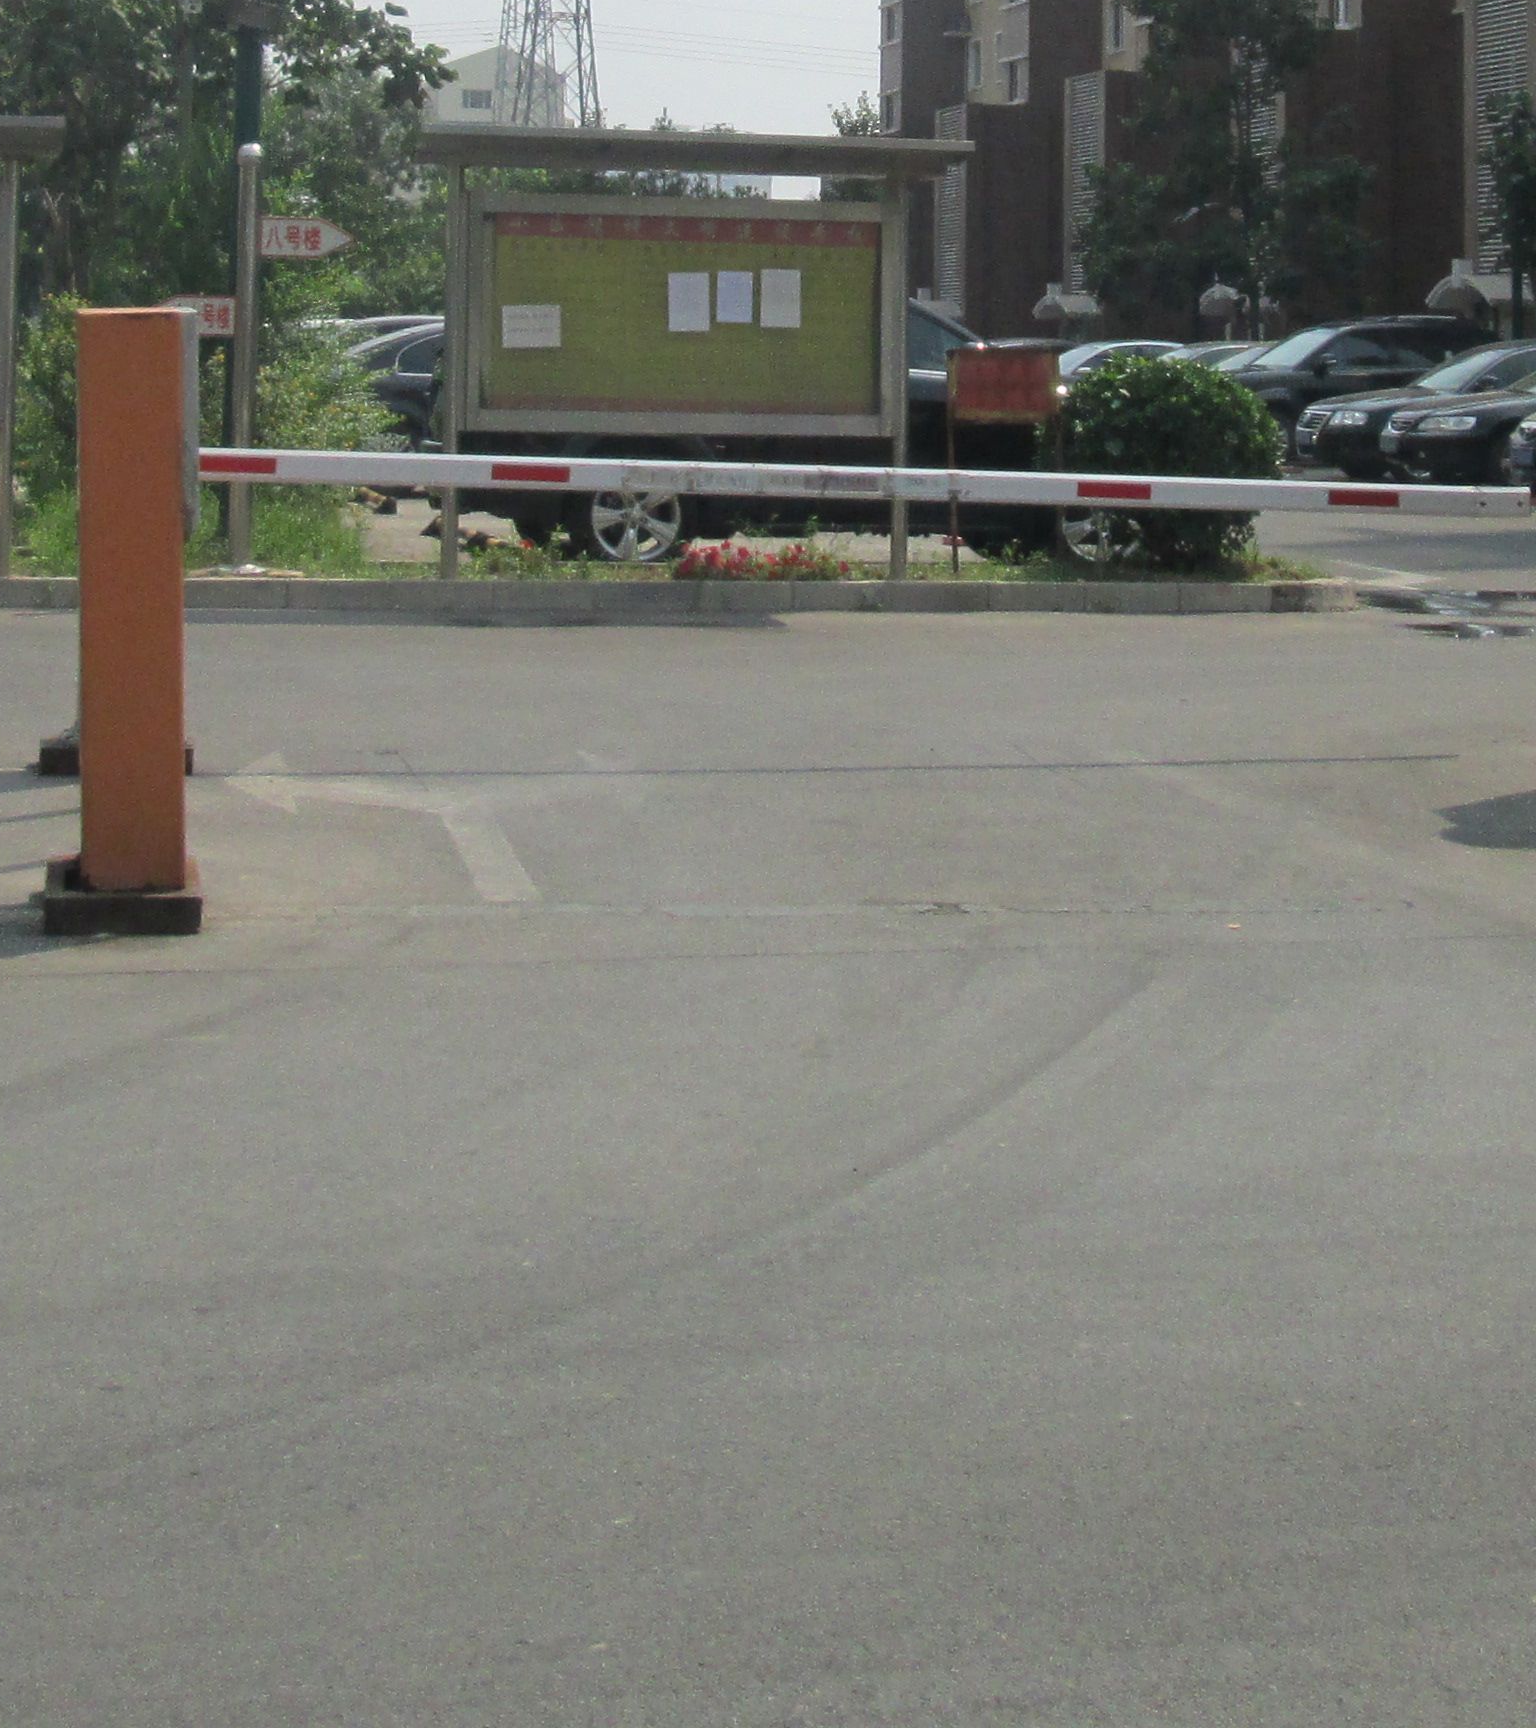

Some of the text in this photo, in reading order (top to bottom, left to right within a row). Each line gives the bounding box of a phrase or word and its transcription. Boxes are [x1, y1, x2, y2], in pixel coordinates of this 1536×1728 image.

[265, 225, 322, 251] 八号楼
[201, 304, 231, 329] 号楼
